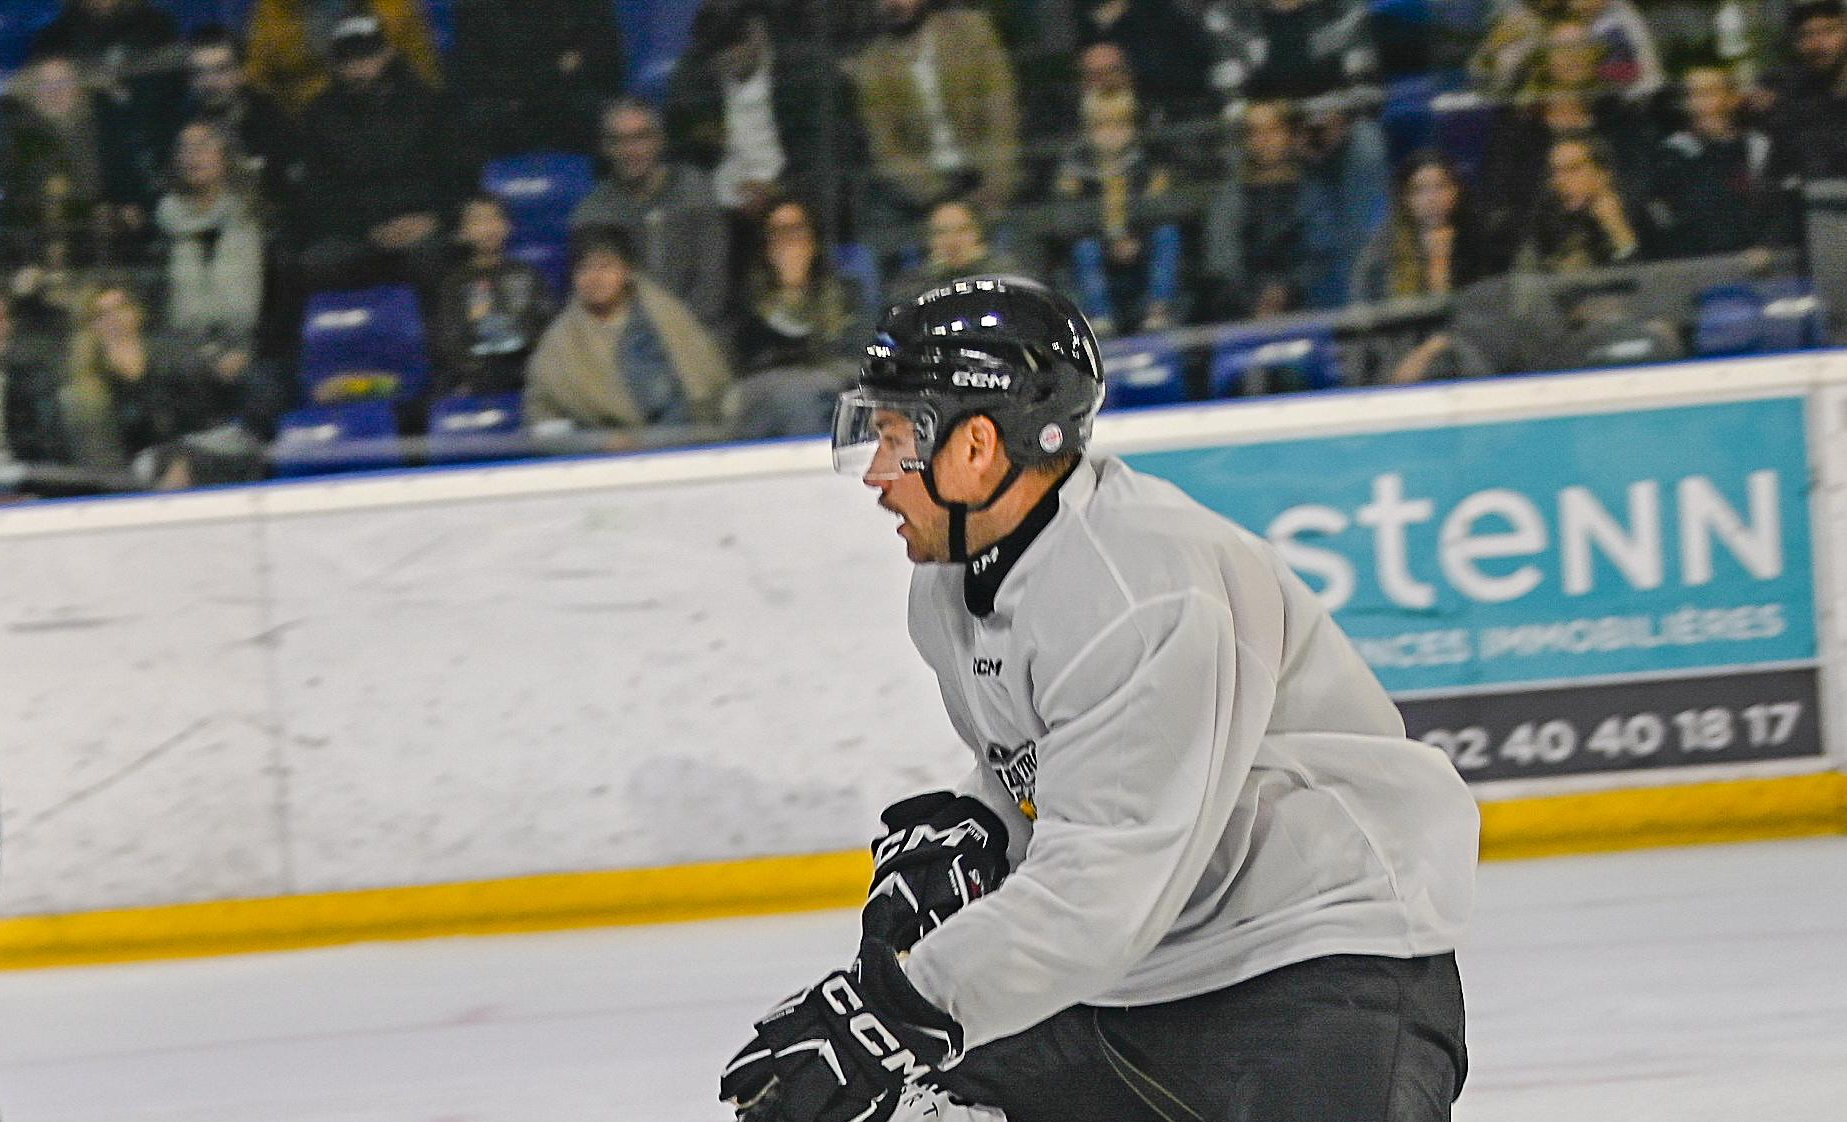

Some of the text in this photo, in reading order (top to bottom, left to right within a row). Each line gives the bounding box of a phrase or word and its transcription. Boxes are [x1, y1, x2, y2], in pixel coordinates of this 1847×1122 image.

[973, 658, 1002, 676] CM
[1499, 720, 1577, 764] 40
[1587, 713, 1666, 758] 40
[1673, 707, 1735, 753] 18
[1742, 702, 1803, 747] 17
